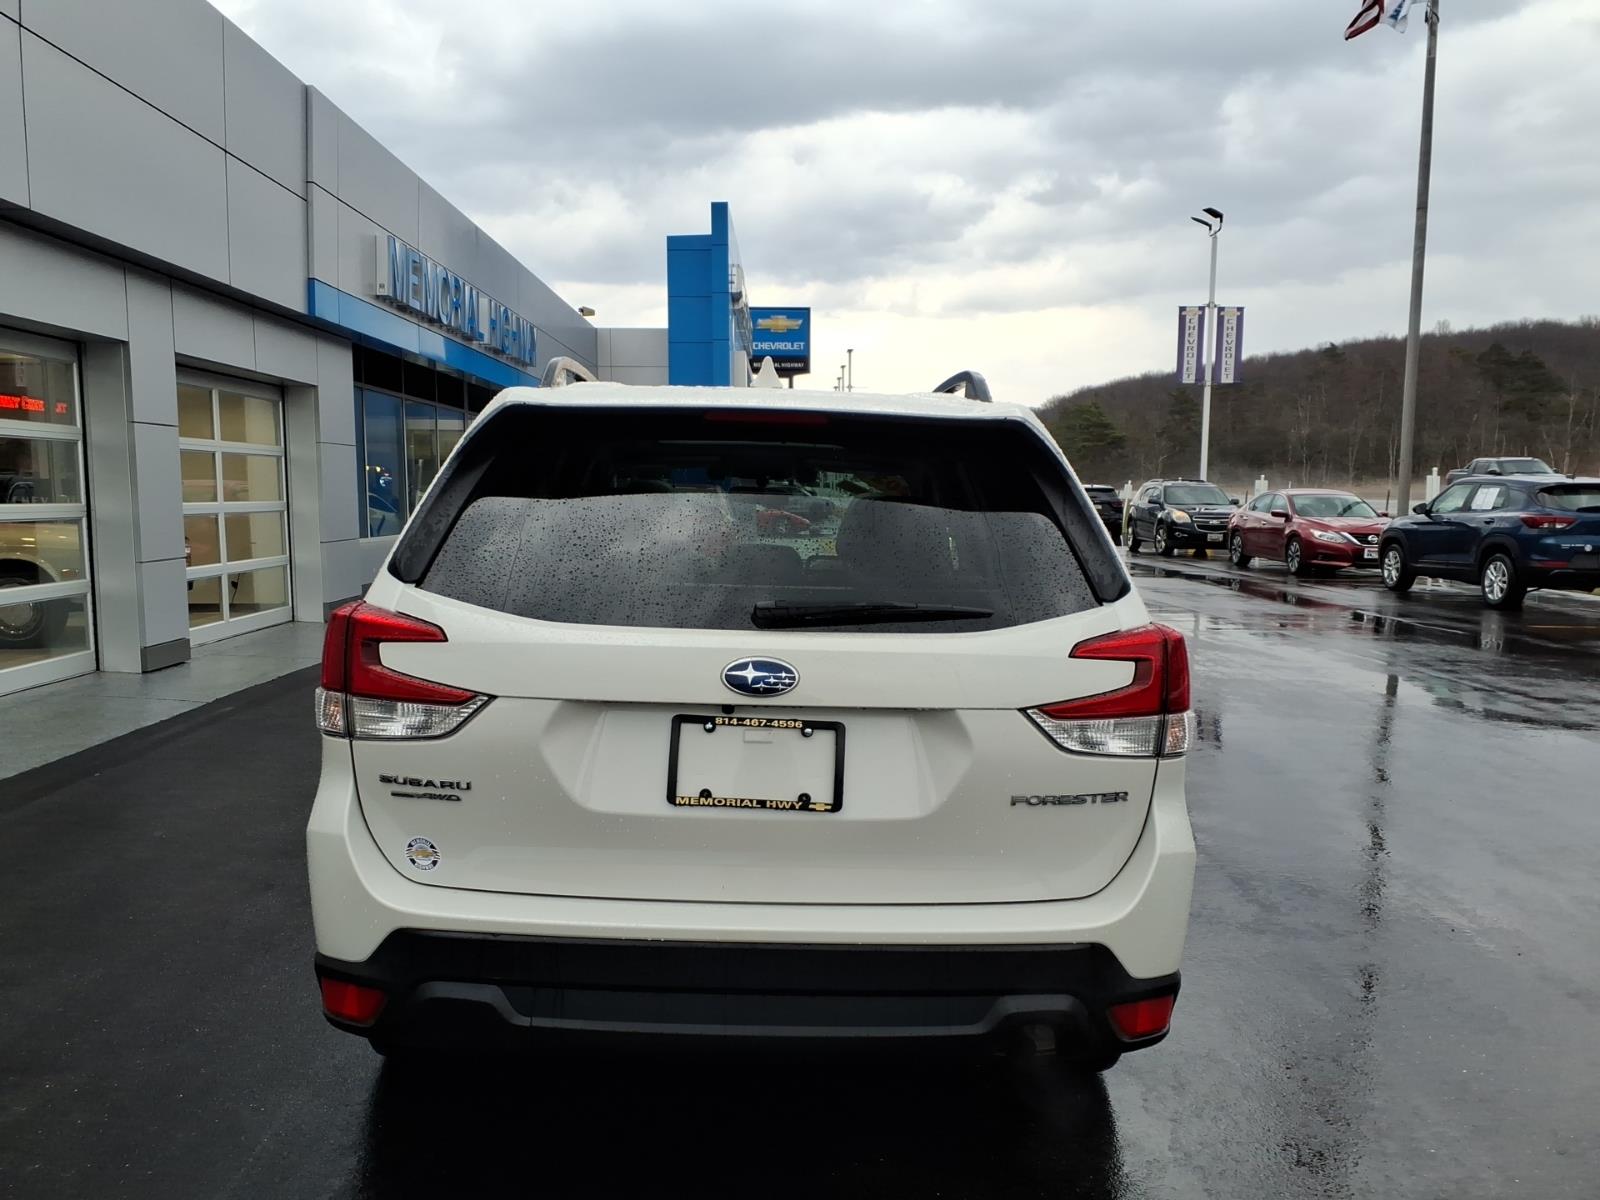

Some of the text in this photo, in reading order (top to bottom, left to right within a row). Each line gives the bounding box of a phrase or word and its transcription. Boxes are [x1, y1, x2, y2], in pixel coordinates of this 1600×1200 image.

[386, 235, 485, 342] MEMORIAL
[752, 342, 805, 350] CHEVROLET
[1186, 318, 1196, 379] CHEVROLET
[1224, 318, 1234, 379] CHEVROLET
[715, 717, 803, 728] 814-467-4596
[379, 774, 472, 791] SUBARU
[675, 796, 803, 810] MEMORIAL HWY
[1010, 791, 1129, 806] FORESTER
